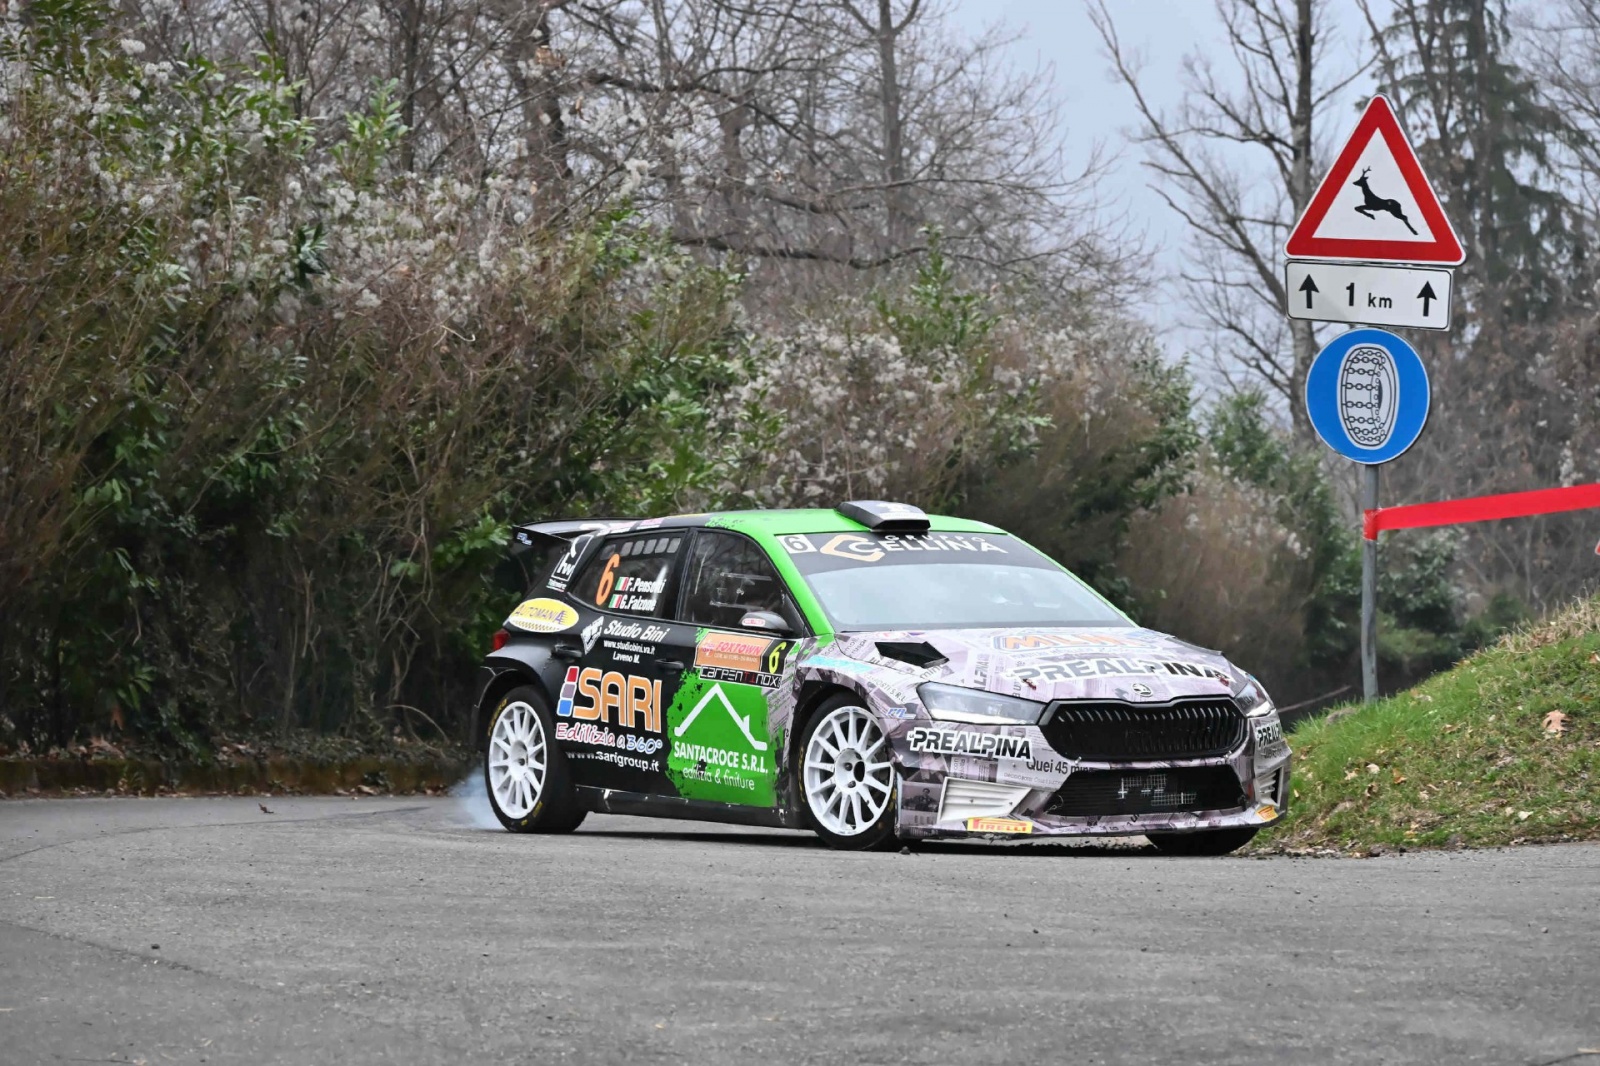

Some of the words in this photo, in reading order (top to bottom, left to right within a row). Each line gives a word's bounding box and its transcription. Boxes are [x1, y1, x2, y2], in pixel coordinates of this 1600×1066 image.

[1345, 282, 1355, 307] 1
[1367, 292, 1393, 309] km
[787, 536, 808, 551] 6
[849, 540, 1009, 556] CELLINA
[595, 553, 621, 606] 6
[604, 619, 643, 640] Studio
[640, 625, 671, 643] Bini
[715, 641, 763, 657] FOXTOWN
[768, 641, 787, 675] 6
[1014, 658, 1231, 683] PREALPINA
[572, 666, 663, 734] SARI
[555, 722, 616, 748] Edilizia
[913, 730, 1032, 760] PREALPINA
[674, 741, 740, 768] SANTACROCE
[741, 753, 769, 774] S.R.L.
[1055, 760, 1069, 775] 45
[714, 768, 722, 784] &
[723, 769, 755, 791] finiture
[973, 818, 1027, 832] PIRELLI
